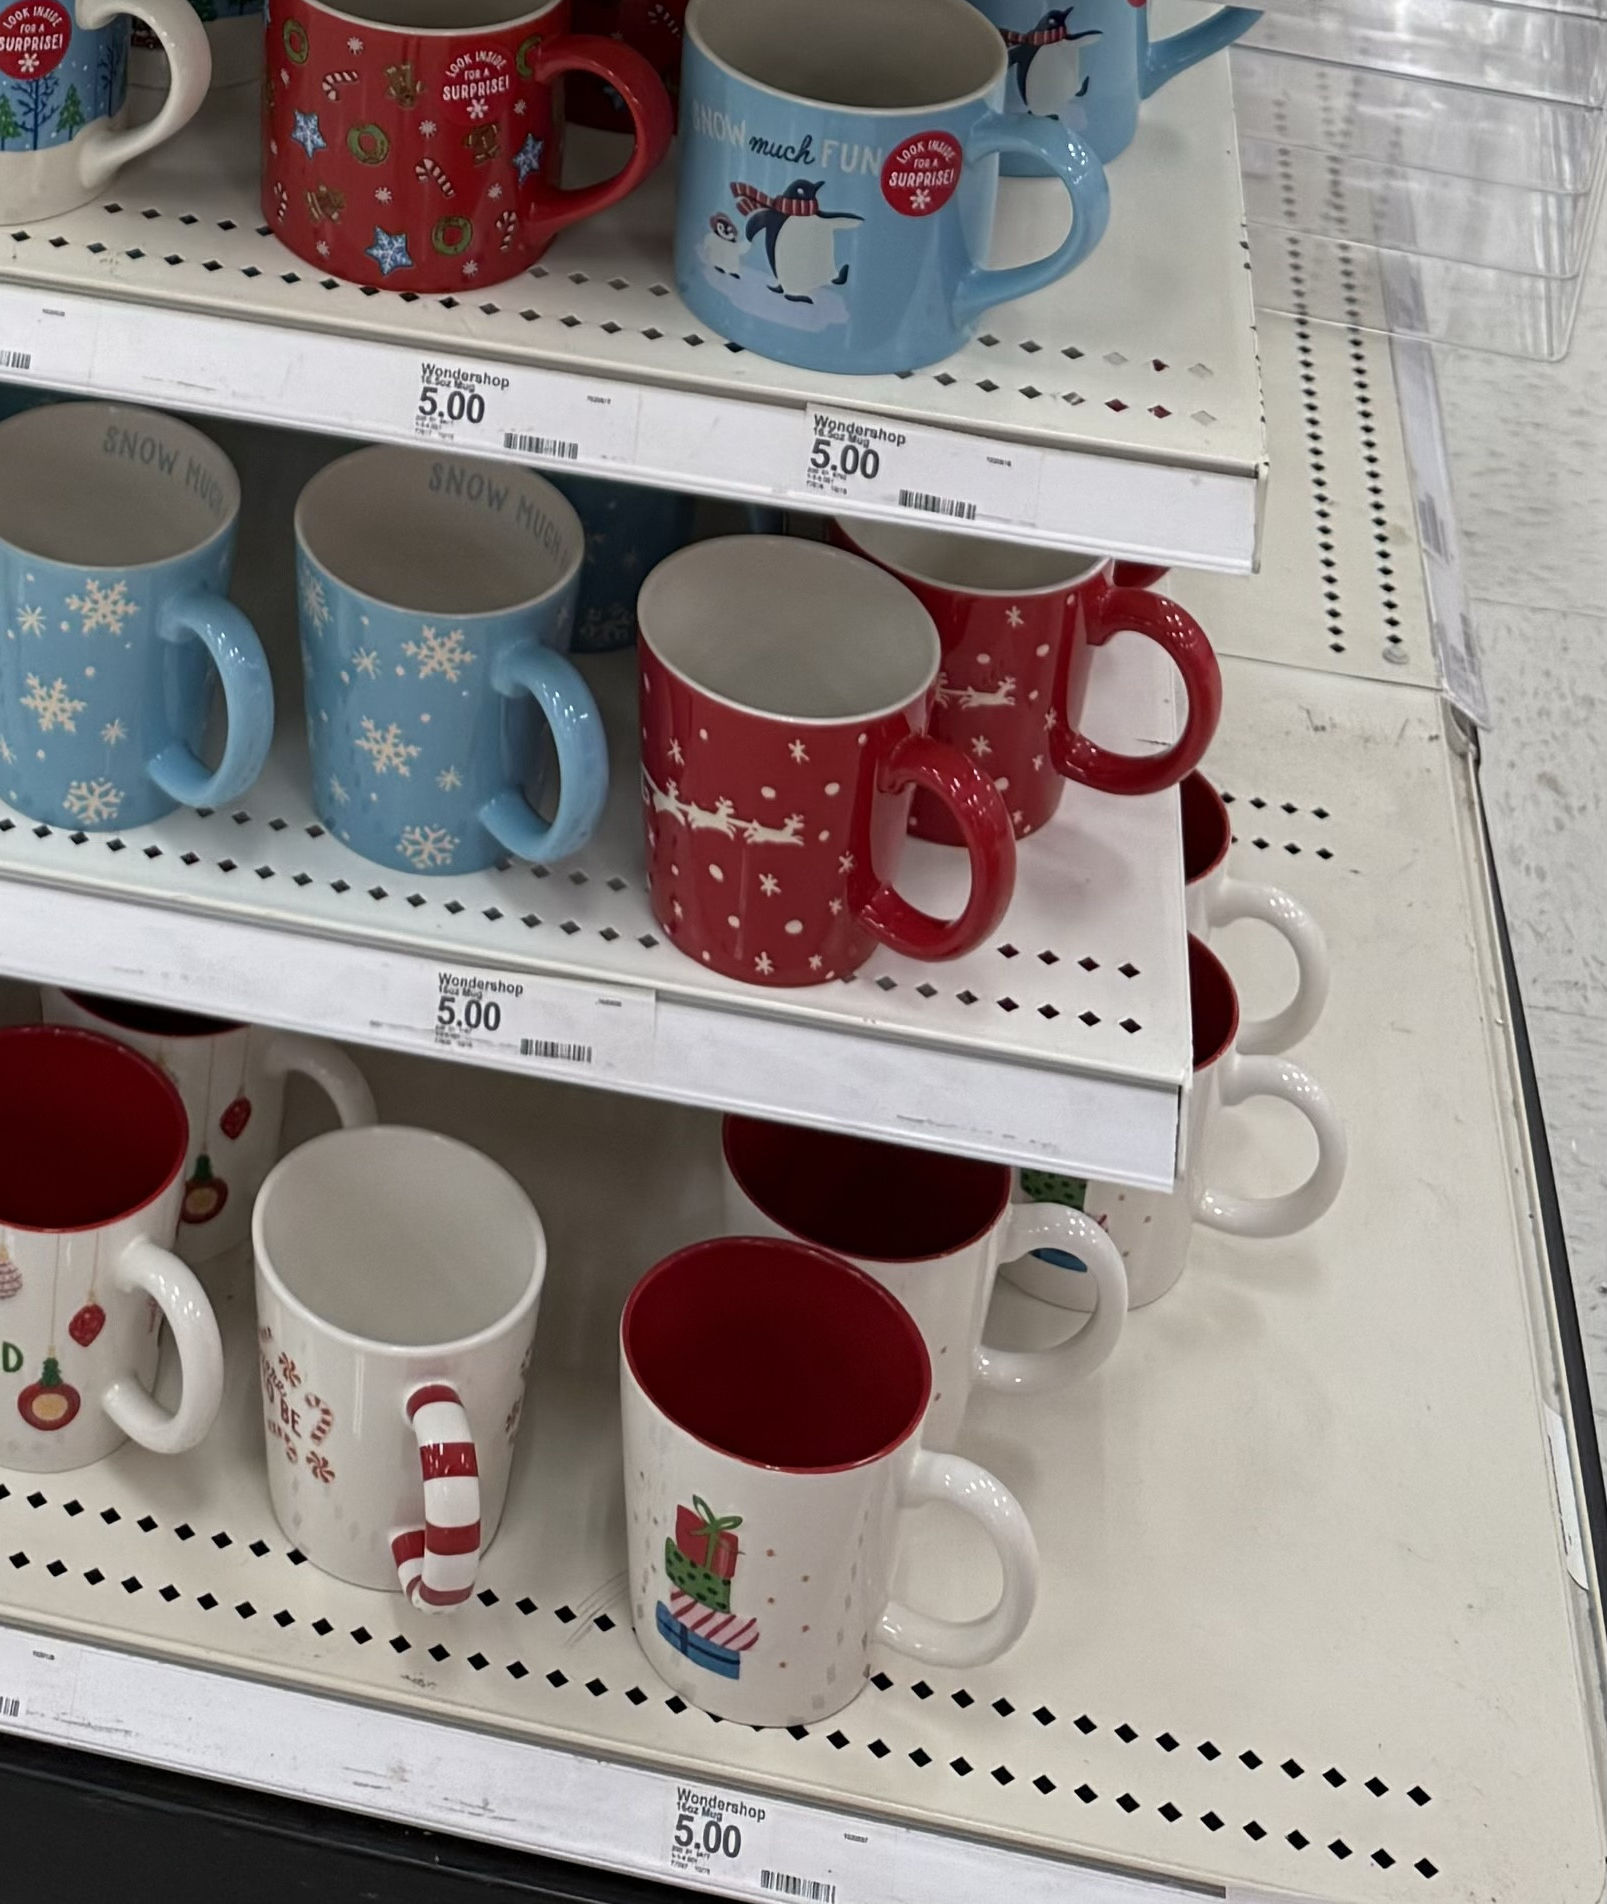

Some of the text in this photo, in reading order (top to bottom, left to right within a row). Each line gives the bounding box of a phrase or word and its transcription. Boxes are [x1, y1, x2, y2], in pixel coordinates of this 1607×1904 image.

[2, 6, 64, 30] LOOK INSIDE
[444, 50, 507, 79] LOOK INSIDE
[442, 74, 510, 102] SURPRISE!
[748, 134, 815, 166] much
[819, 138, 882, 176] FUN
[895, 139, 956, 164] LOOK INSIDE
[888, 168, 955, 187] SURPRISE!
[421, 363, 509, 390] Wondershop
[418, 386, 485, 423] 5.00
[814, 413, 906, 447] Wondershop
[103, 425, 179, 475] SNOW
[810, 438, 879, 479] 5.00
[428, 463, 510, 512] SNOW
[438, 972, 523, 998] Wondershop
[437, 995, 501, 1031] 5.00
[677, 1787, 766, 1822] Wondershop
[674, 1813, 742, 1858] 5.00
